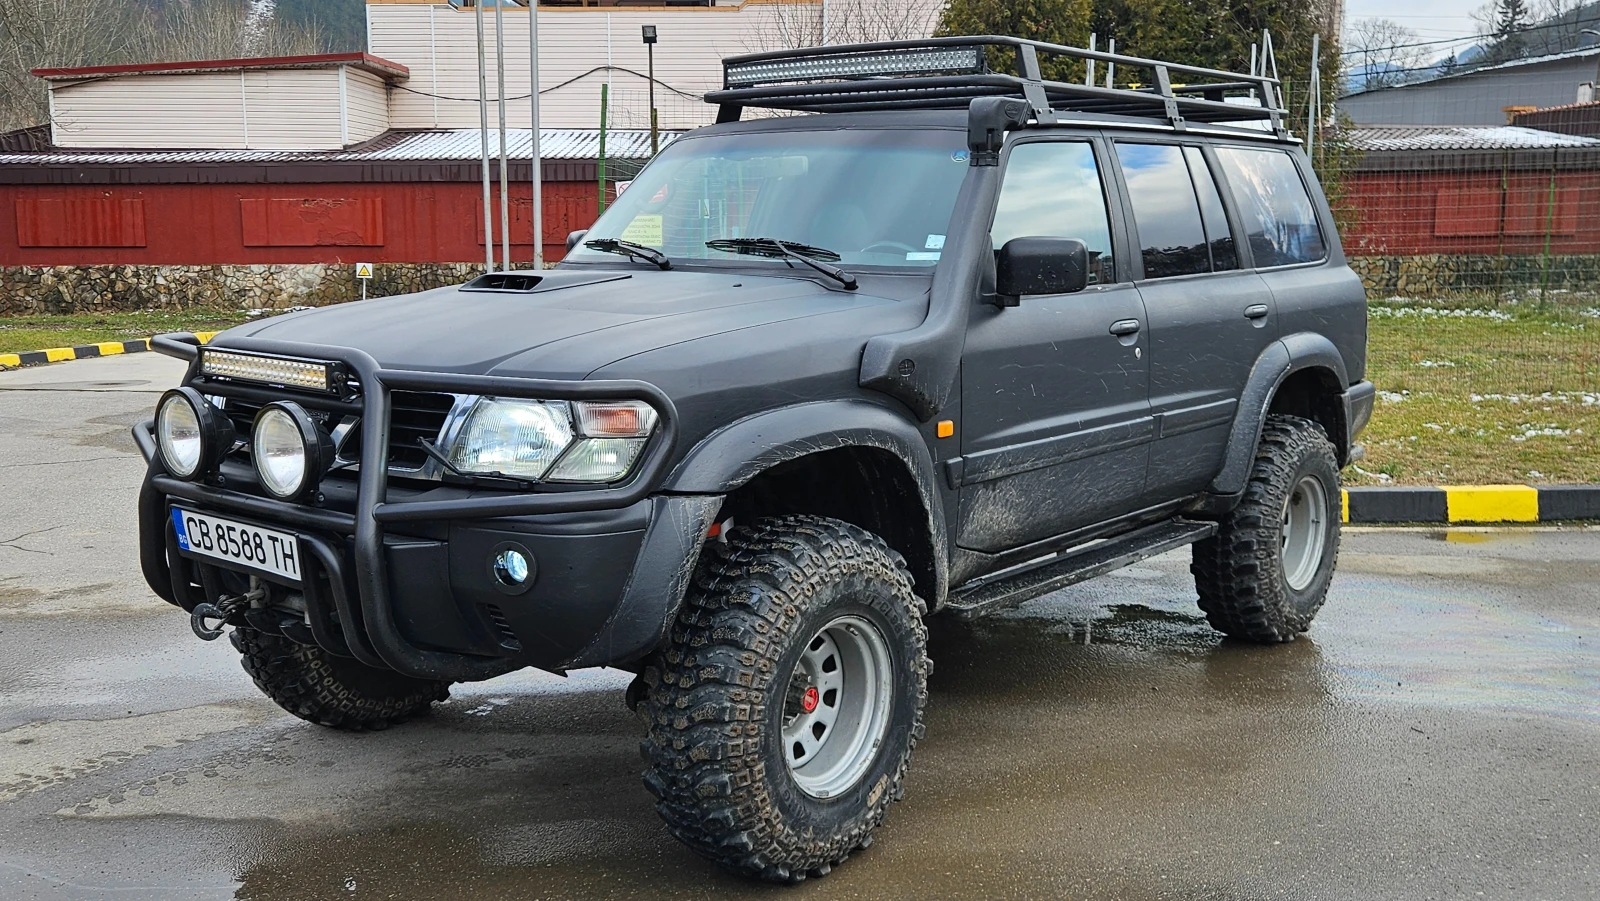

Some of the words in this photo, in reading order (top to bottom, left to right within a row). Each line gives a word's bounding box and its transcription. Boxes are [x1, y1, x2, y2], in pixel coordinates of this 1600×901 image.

[178, 533, 188, 544] BG
[186, 516, 213, 551] CB
[215, 523, 267, 565] 8588
[267, 534, 297, 575] TH
